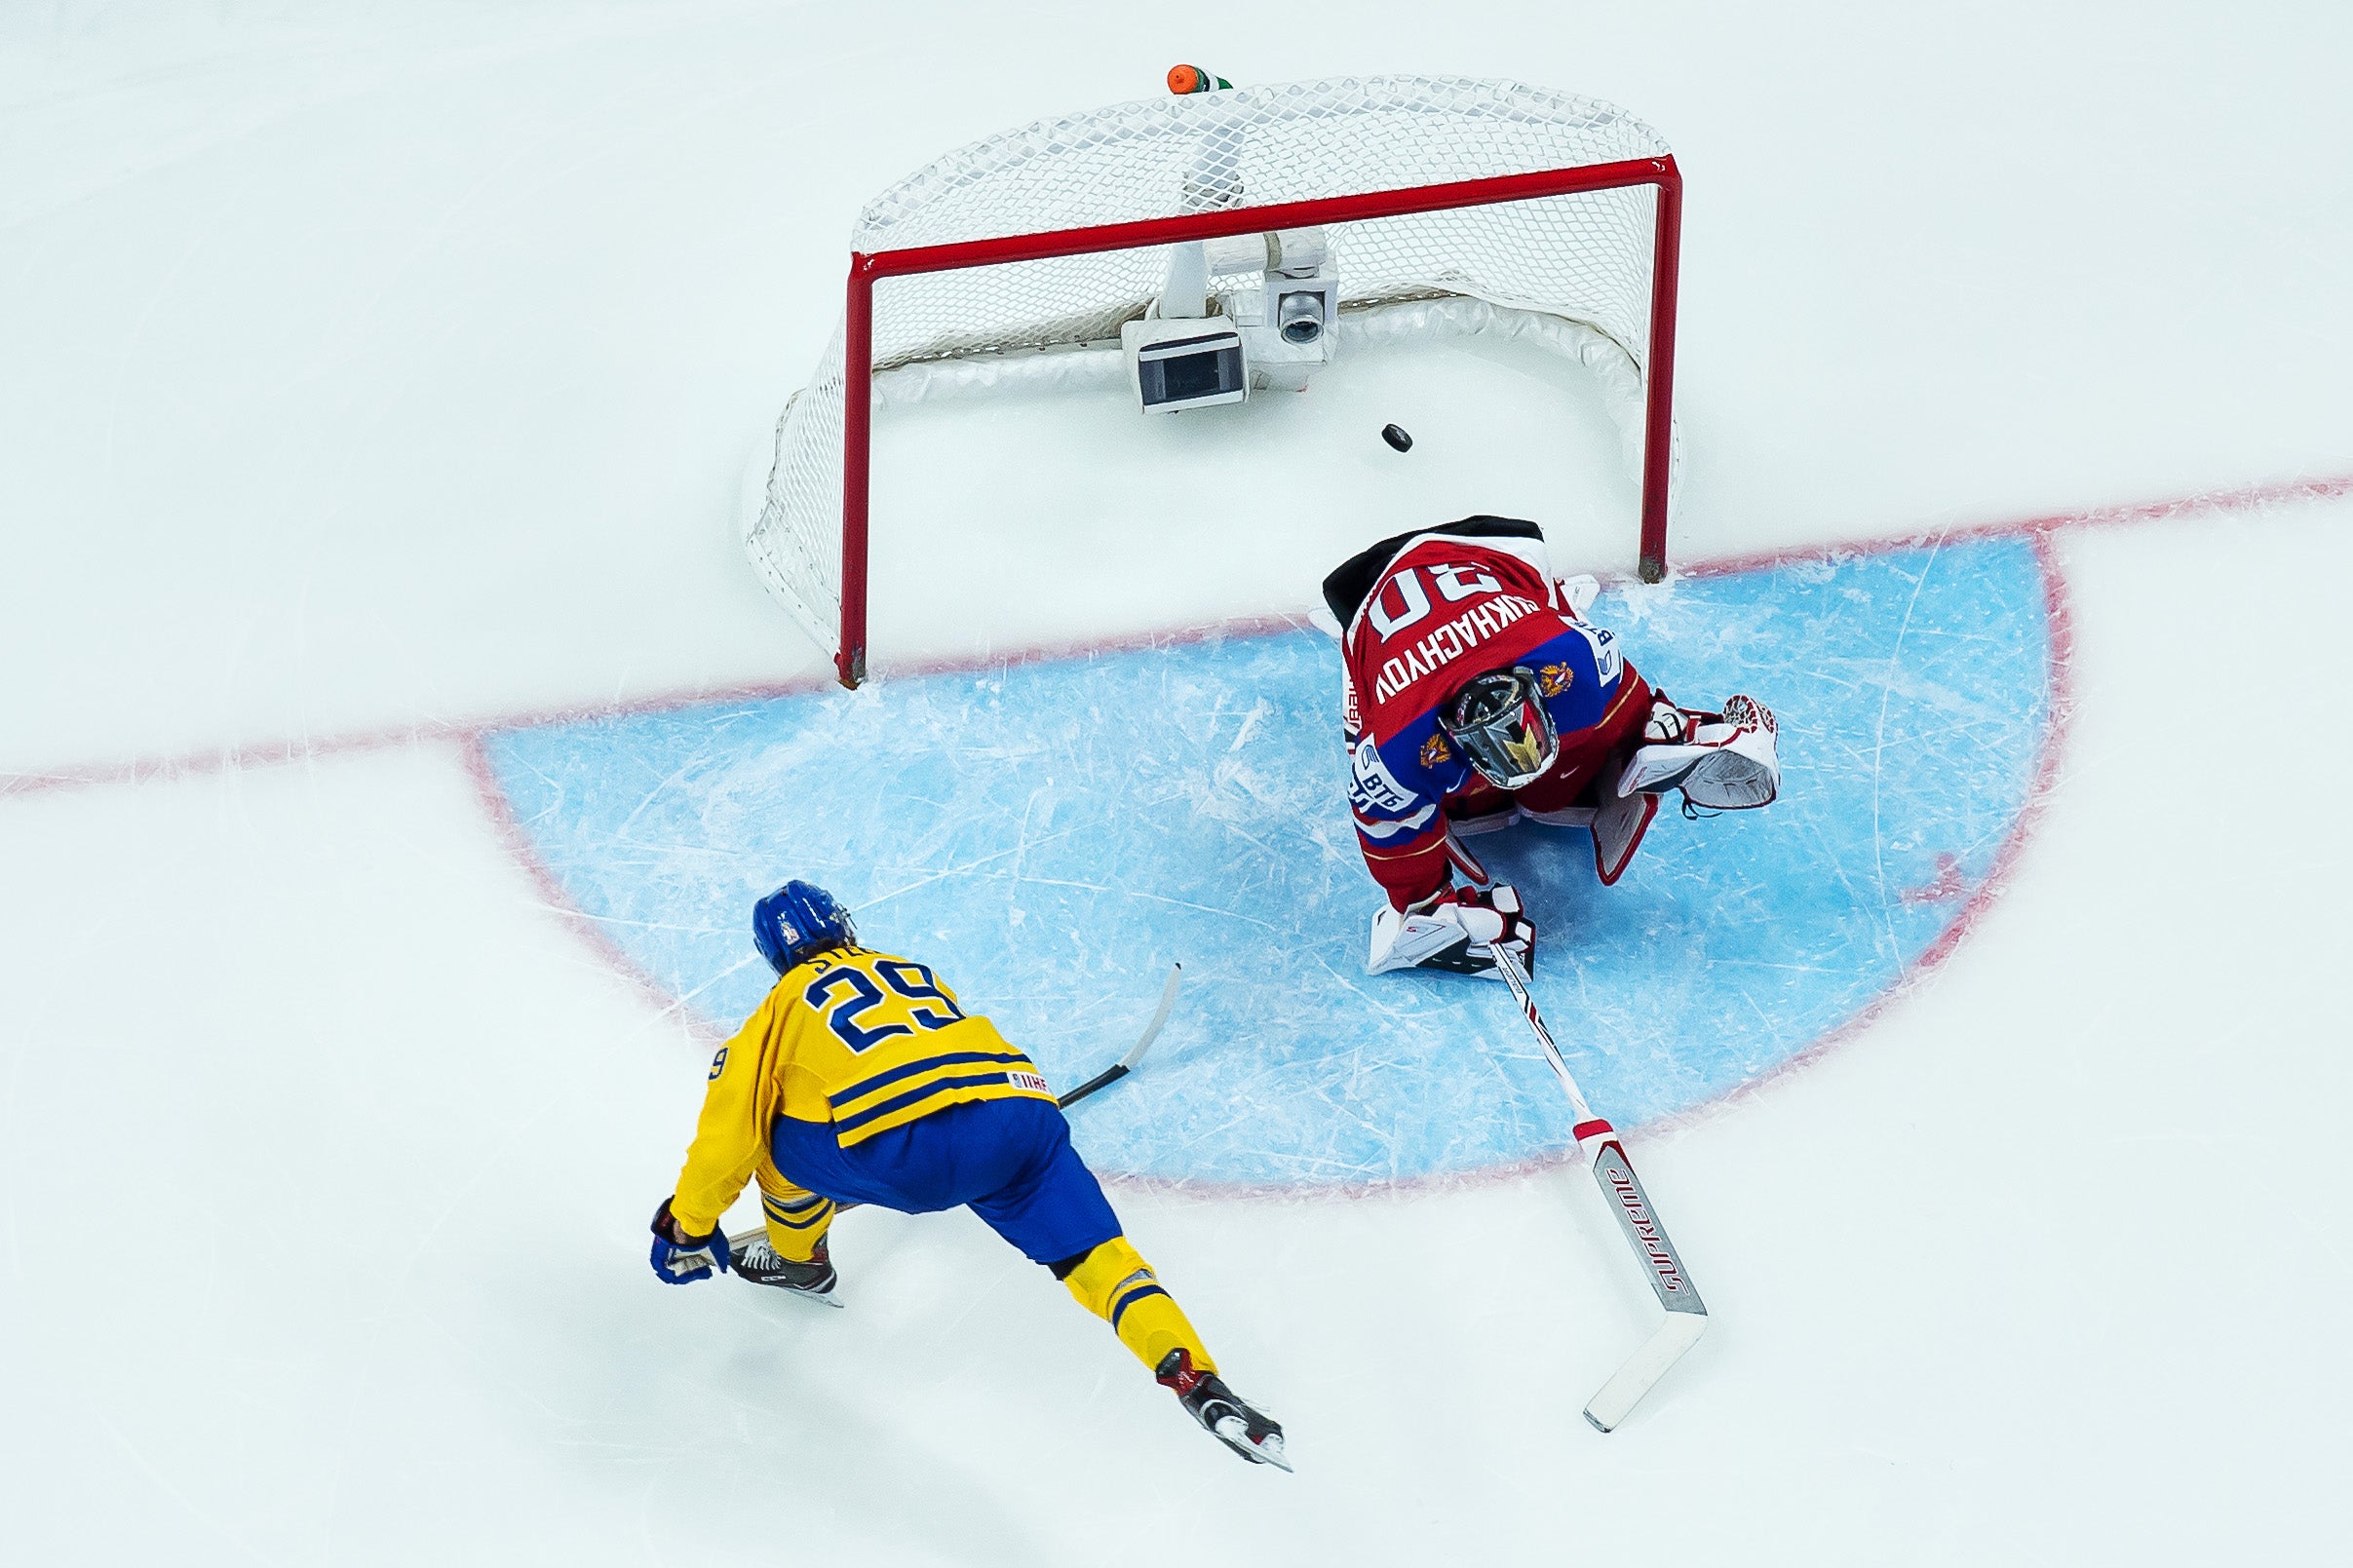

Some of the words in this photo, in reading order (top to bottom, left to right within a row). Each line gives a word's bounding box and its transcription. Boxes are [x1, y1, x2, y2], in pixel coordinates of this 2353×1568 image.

[1375, 594, 1541, 705] SUKHACHYOV
[803, 958, 967, 1056] 29
[1020, 1074, 1048, 1091] IIHF
[1606, 1168, 1690, 1295] SUPREME
